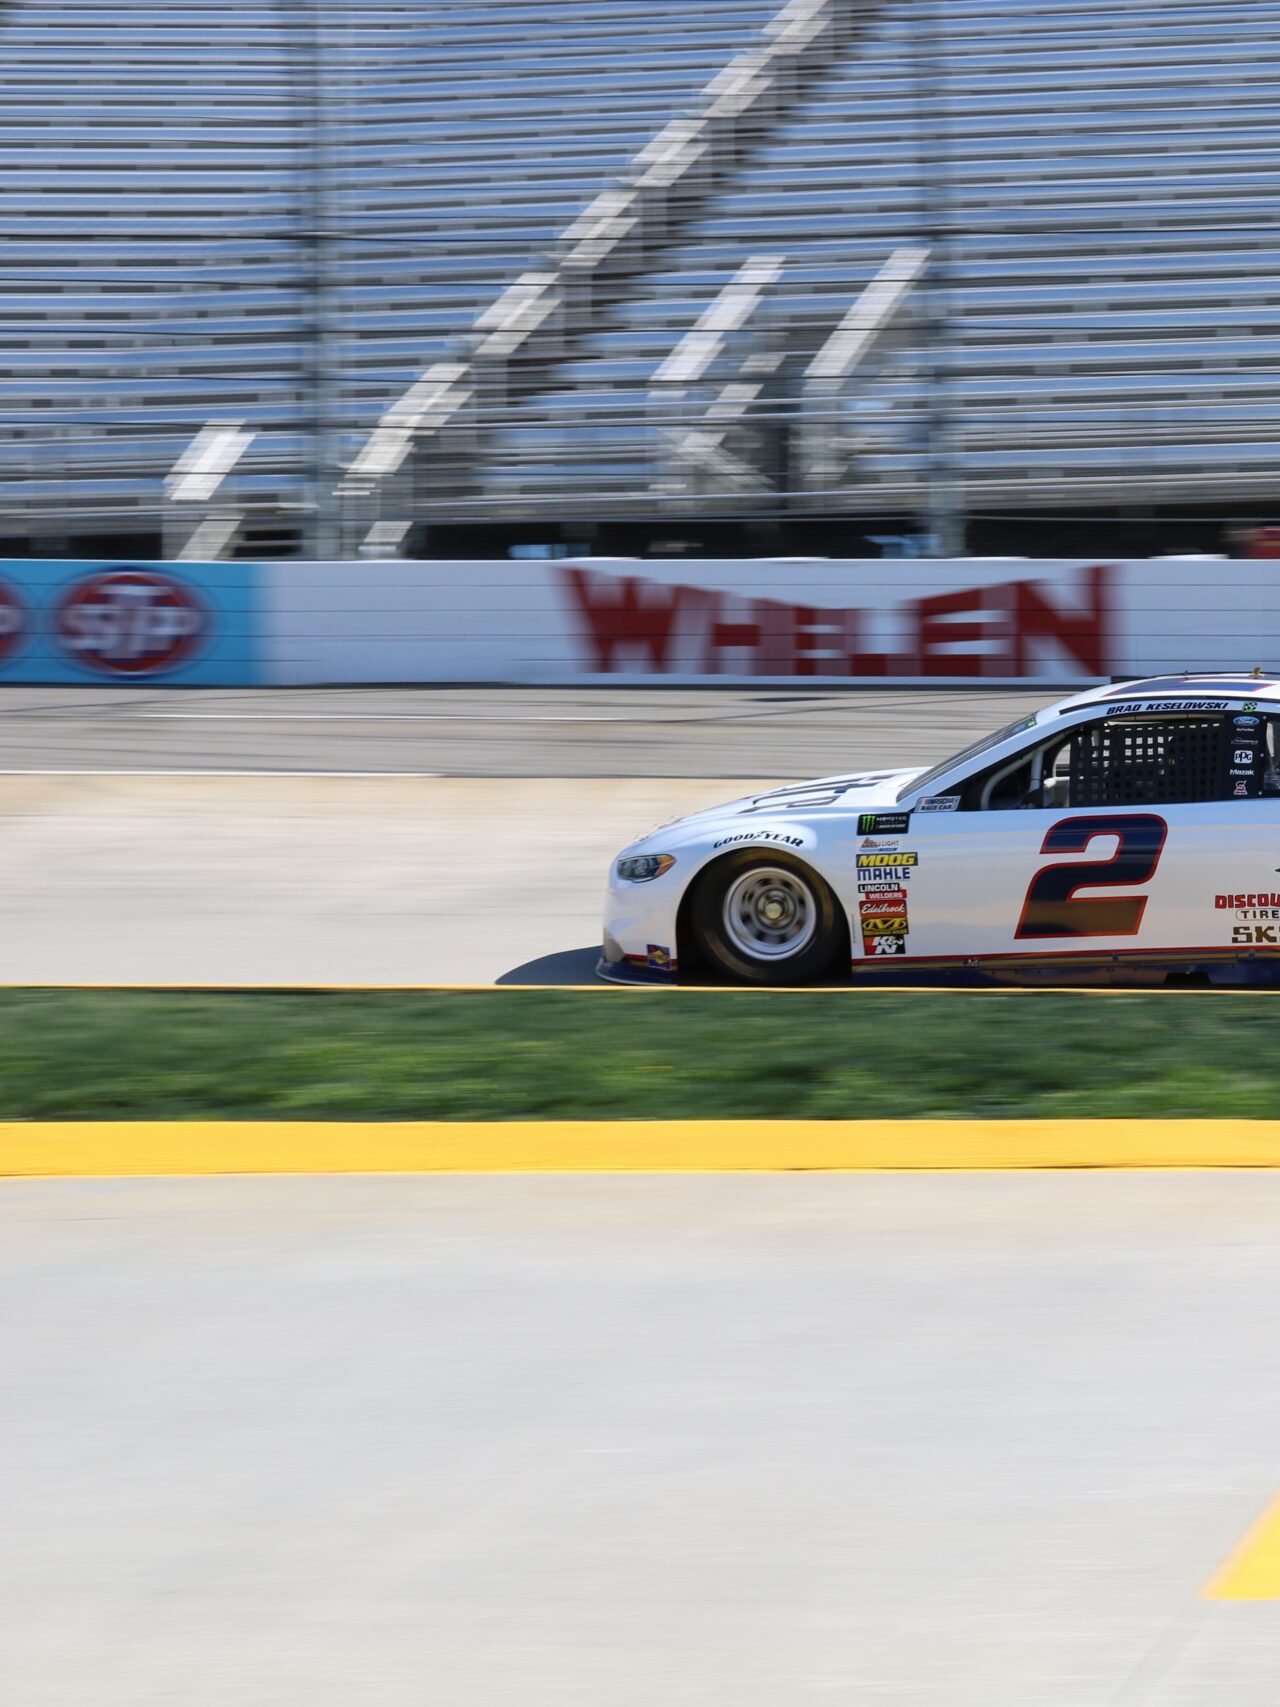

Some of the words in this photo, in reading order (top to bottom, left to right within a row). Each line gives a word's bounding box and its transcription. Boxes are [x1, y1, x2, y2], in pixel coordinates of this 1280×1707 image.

[1106, 704, 1142, 715] BRAD
[1145, 702, 1229, 711] KESELOWSKI
[1235, 751, 1252, 762] PPG
[713, 830, 804, 849] GOODYEAR
[858, 854, 915, 866] MOOG
[857, 867, 910, 881] MAHLE
[1014, 813, 1168, 939] 2
[860, 884, 899, 893] LINCOLN
[868, 892, 903, 900] WELDERS
[861, 903, 906, 914] Edelbrock
[1241, 910, 1280, 919] TIRE
